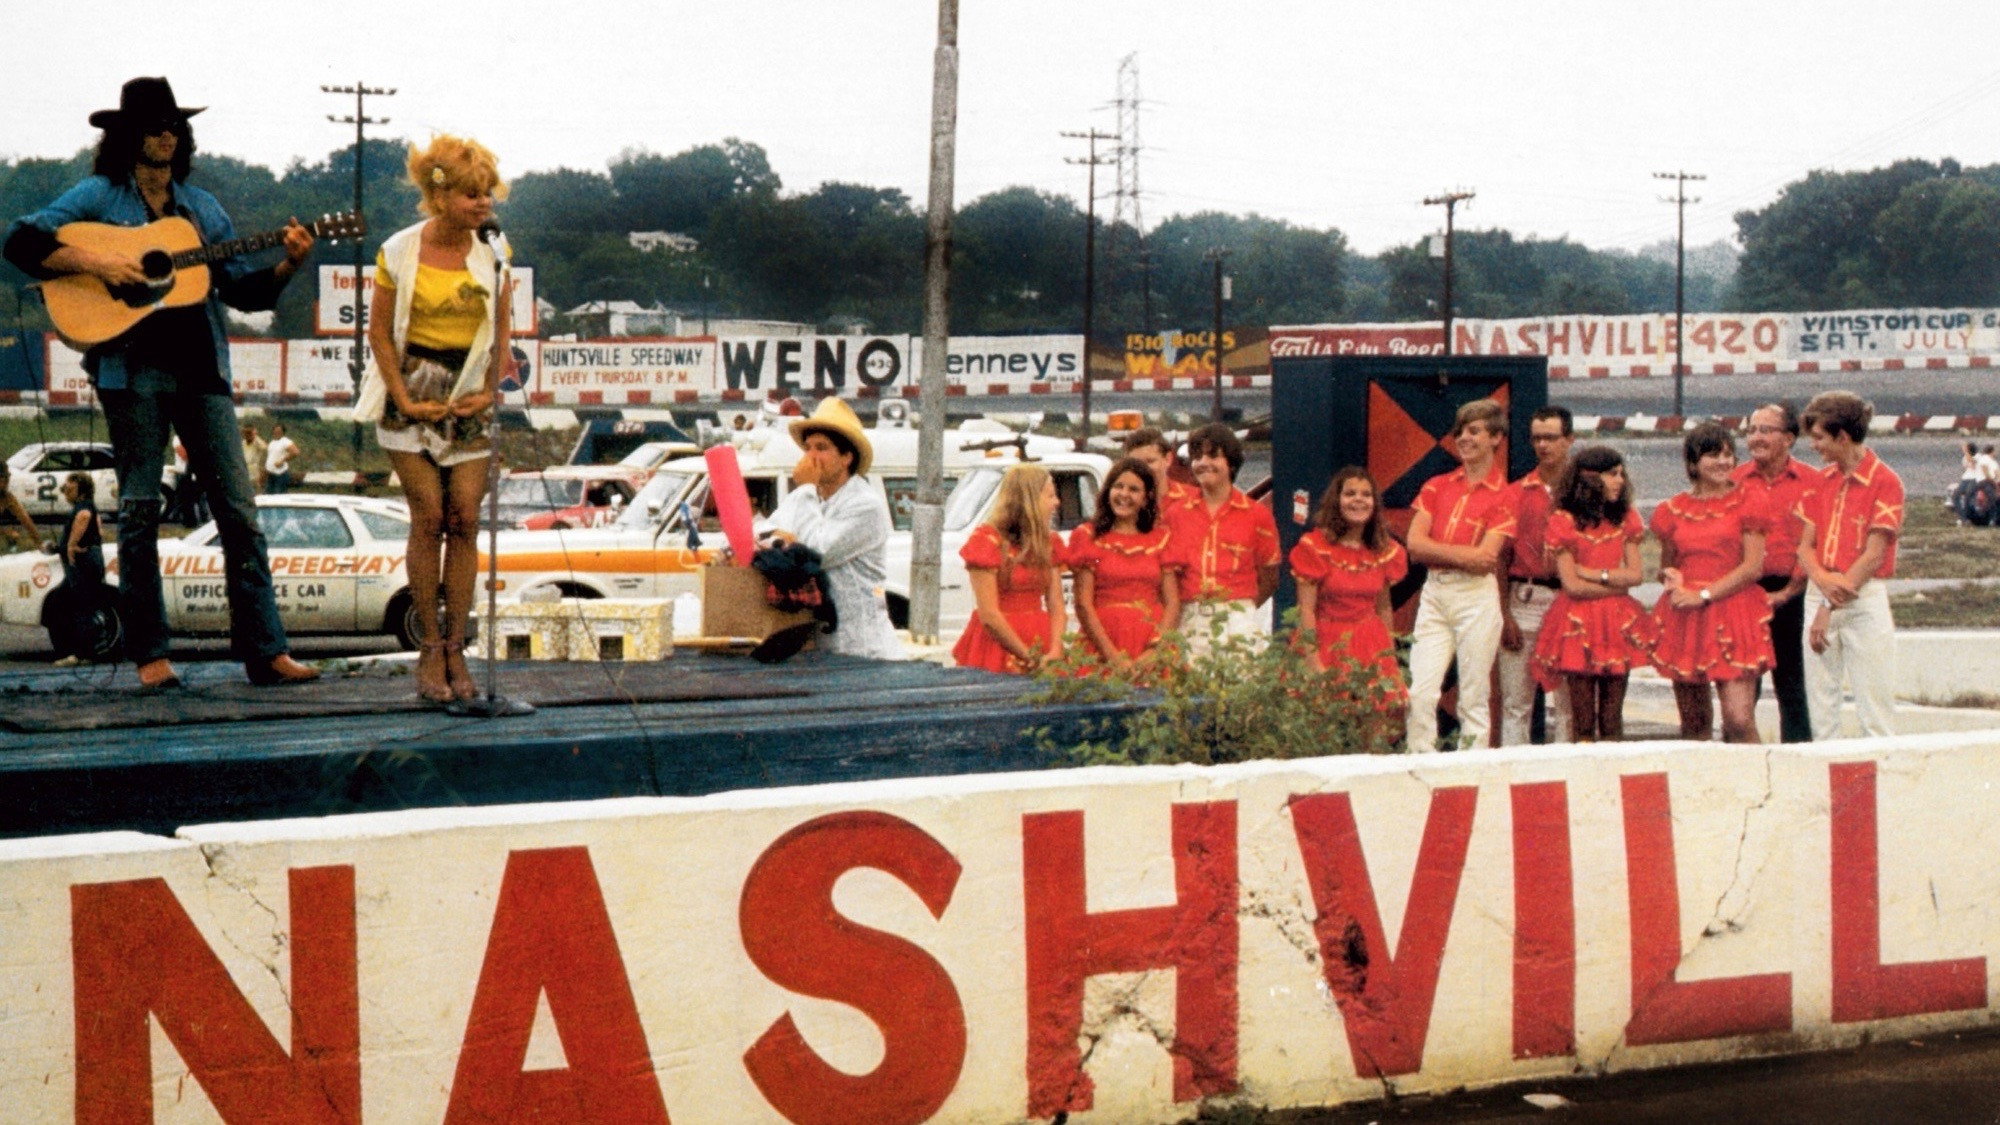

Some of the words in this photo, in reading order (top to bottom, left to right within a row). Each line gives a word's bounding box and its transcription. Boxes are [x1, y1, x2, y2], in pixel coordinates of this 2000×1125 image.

[1926, 313, 1970, 329] CUP
[1456, 318, 1678, 356] NASHVILLE
[1801, 331, 1876, 352] SAT.
[1904, 330, 1970, 350] JULY
[543, 347, 620, 366] HUNTSVILLE
[630, 347, 703, 366] SPEEDWAY
[722, 338, 901, 390] WENO
[946, 353, 1076, 380] enneys
[551, 370, 588, 385] EVERY
[594, 369, 650, 384] THURSDAY
[655, 371, 662, 383] 8
[37, 475, 58, 501] 2
[270, 555, 407, 575] PEEDWAY
[297, 584, 326, 598] CAR
[71, 753, 1988, 1125] NASHVILL
